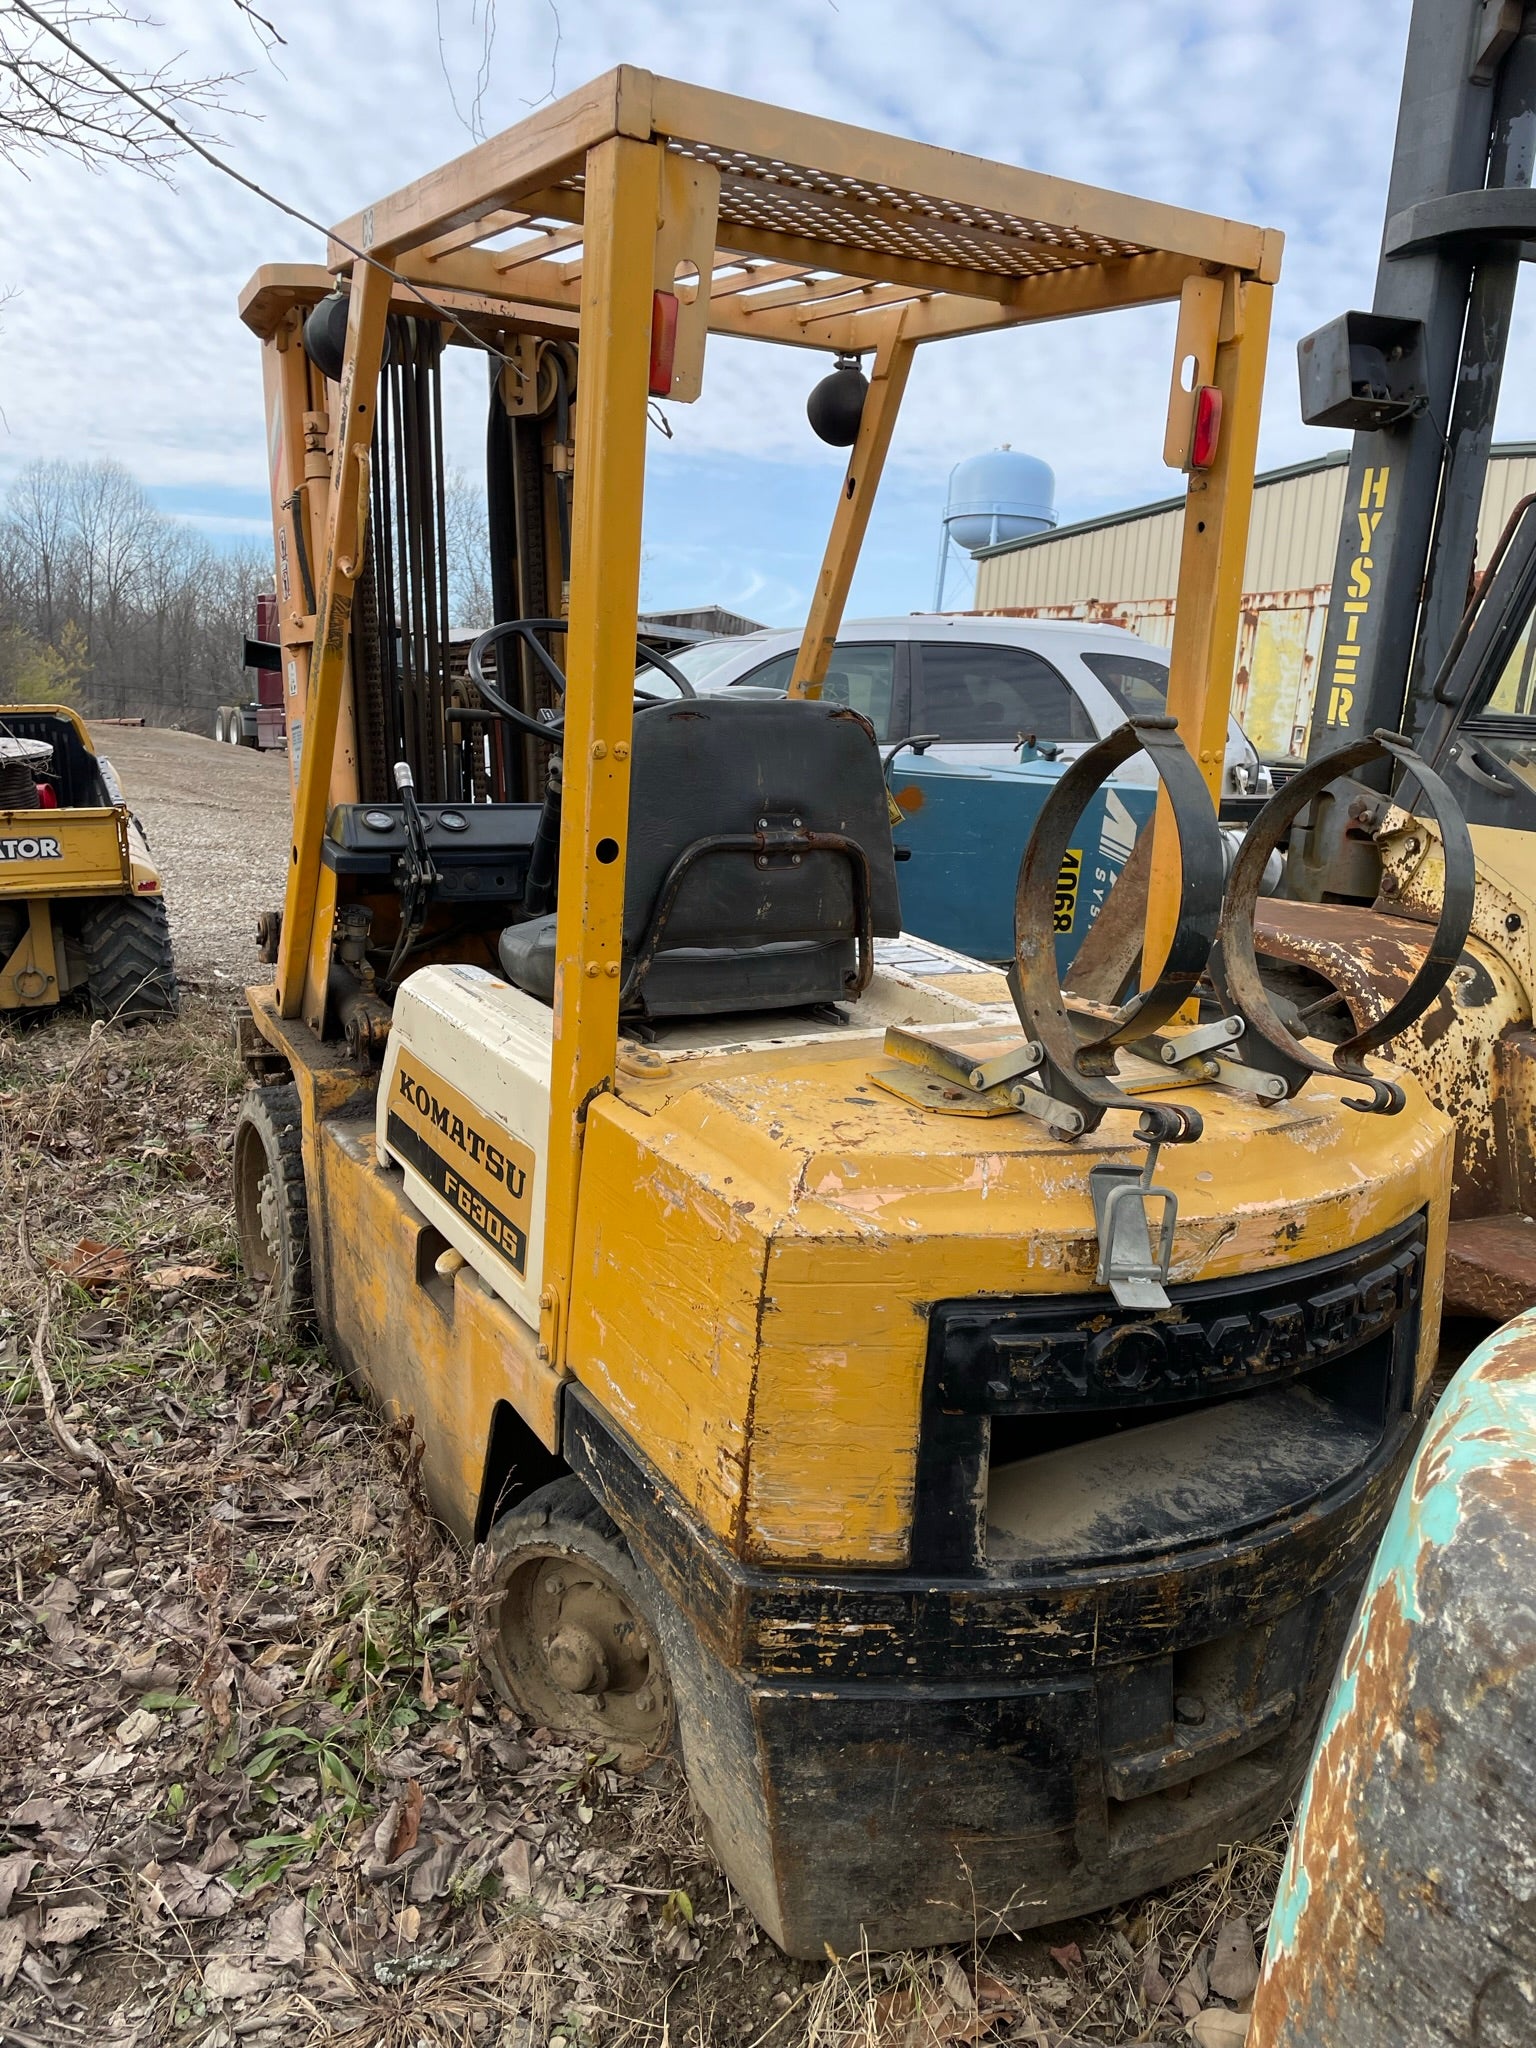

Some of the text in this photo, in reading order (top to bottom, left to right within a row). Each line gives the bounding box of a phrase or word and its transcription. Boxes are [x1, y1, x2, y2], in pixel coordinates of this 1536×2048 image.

[1326, 466, 1391, 728] HYSTER
[399, 1069, 527, 1199] KOMATSU
[444, 1170, 518, 1259] FG30S
[988, 1240, 1426, 1399] KOMATSU
